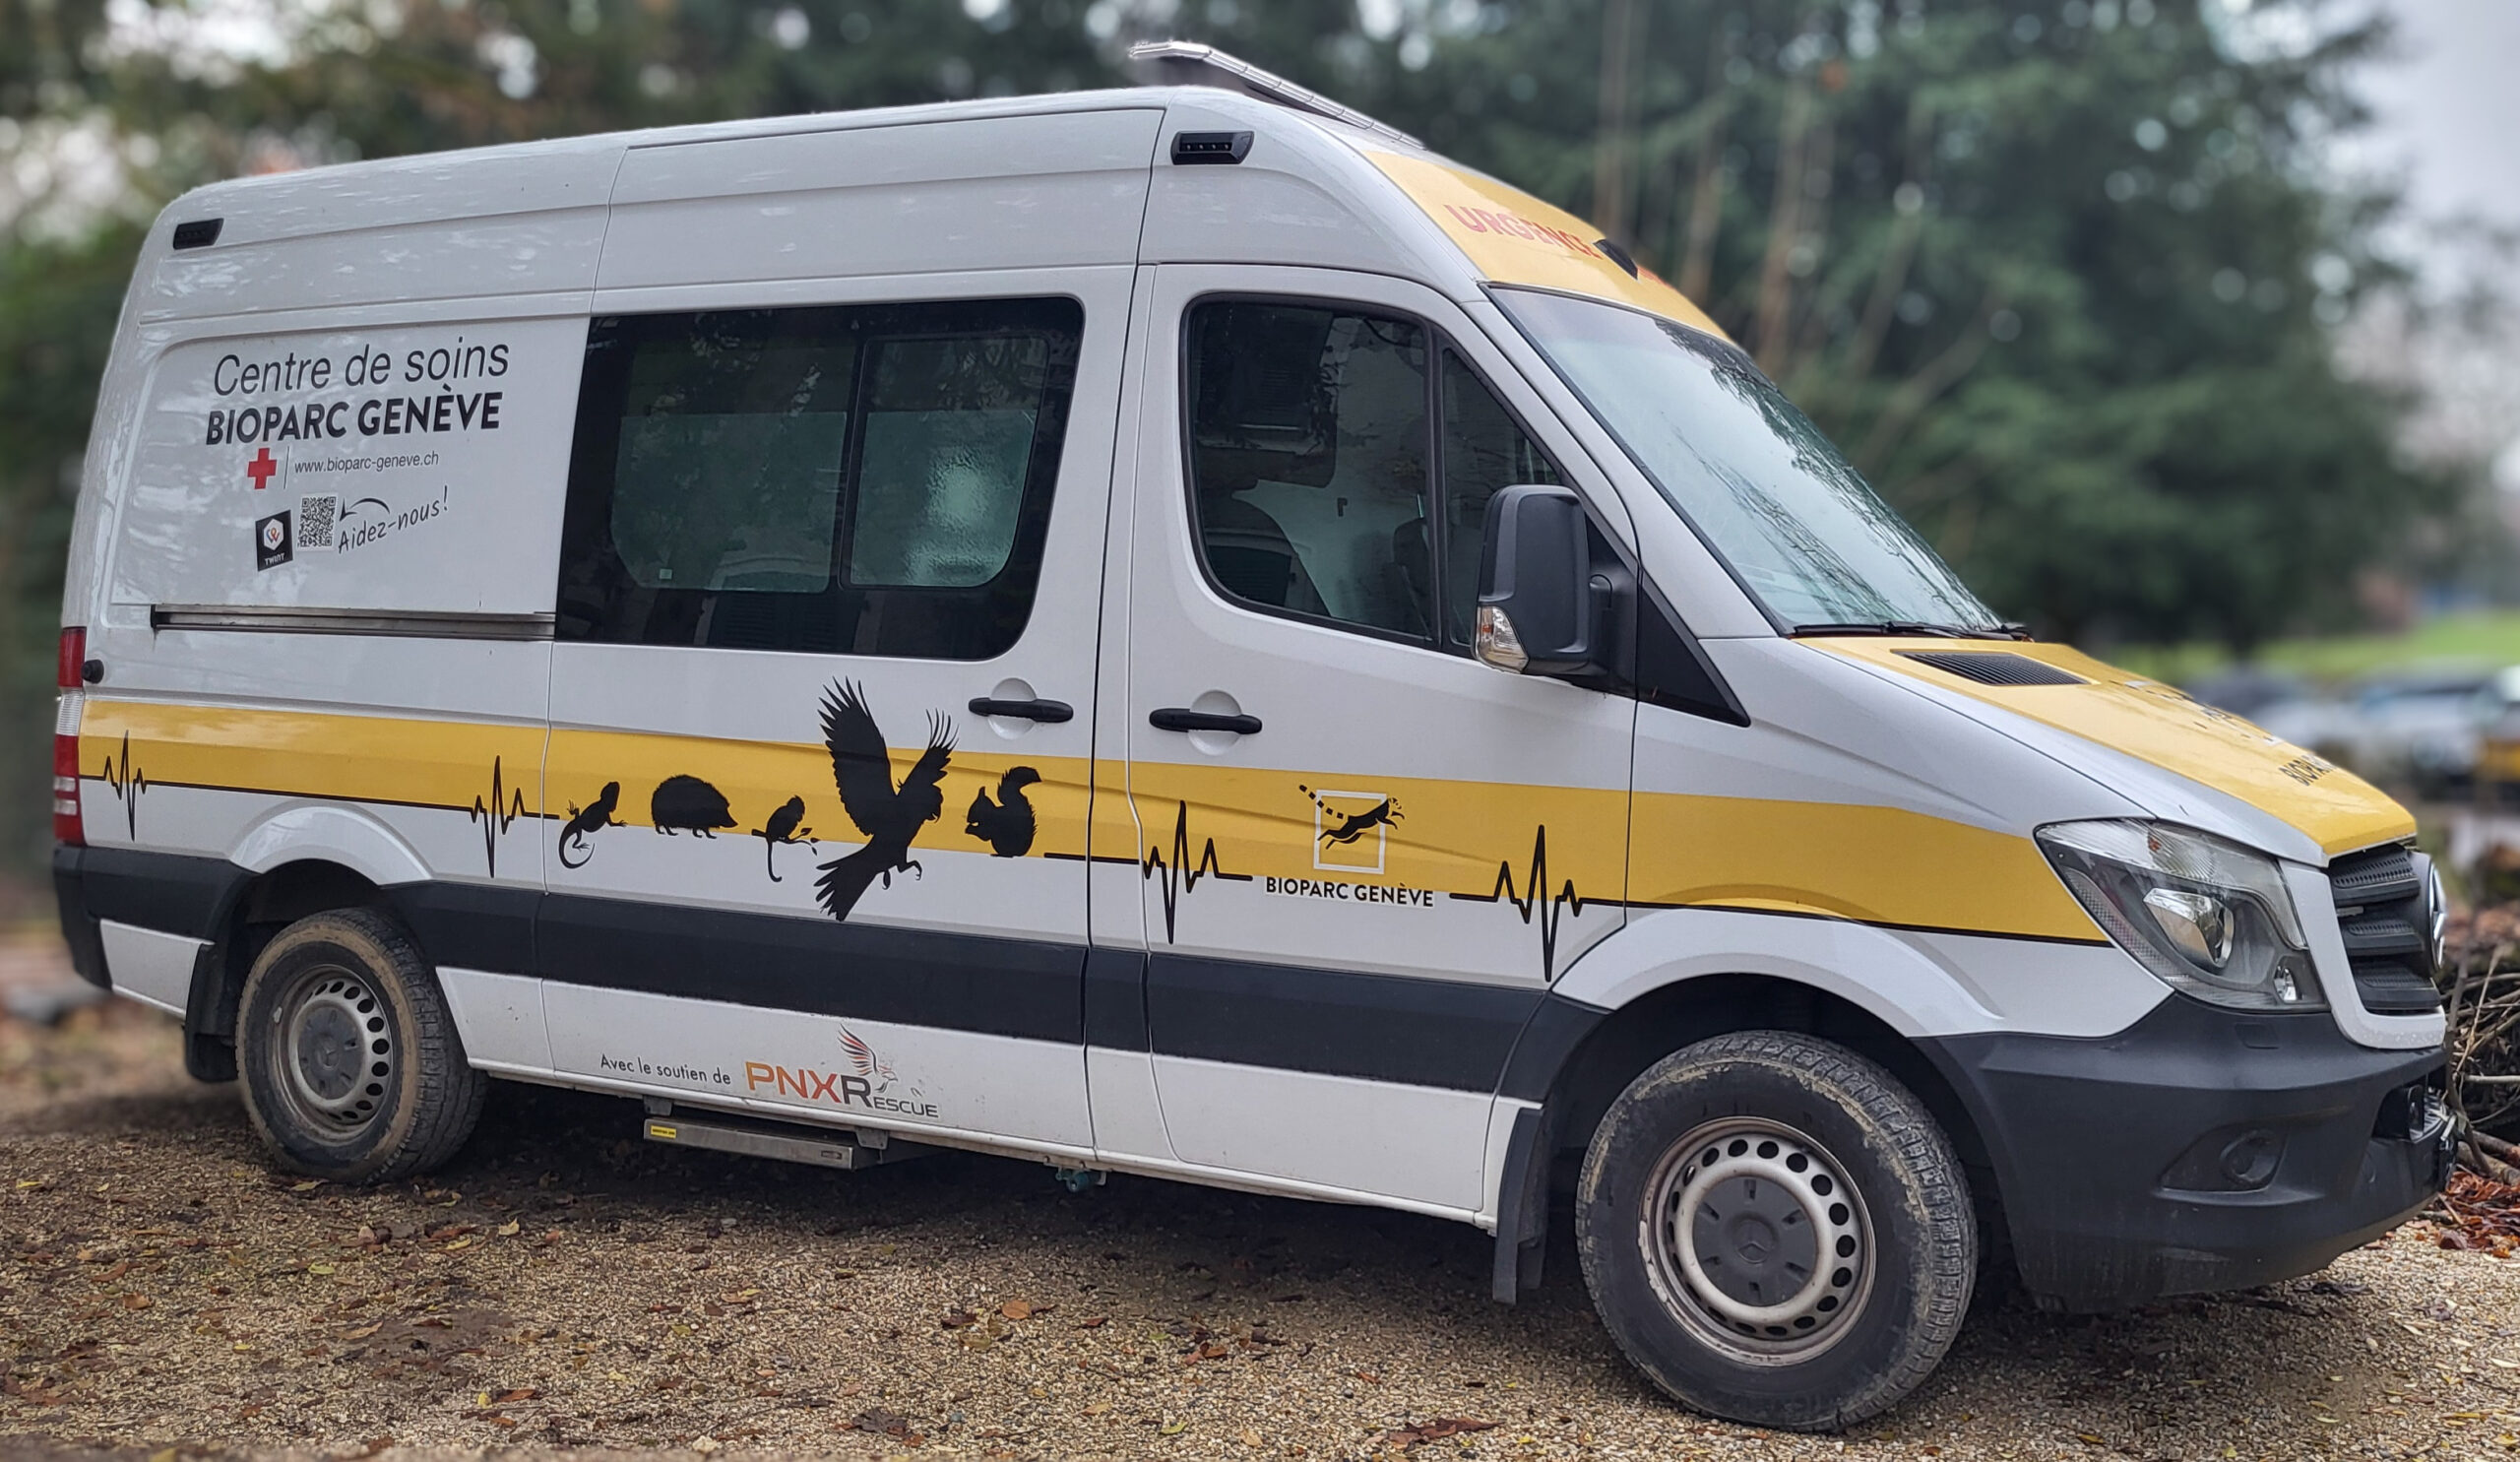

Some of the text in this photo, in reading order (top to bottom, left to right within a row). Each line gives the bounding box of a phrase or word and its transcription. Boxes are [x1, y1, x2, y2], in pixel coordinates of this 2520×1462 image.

[214, 336, 510, 396] Centre de soins
[206, 383, 503, 445] BIOPARC GENÈVE
[294, 451, 440, 474] www.bioparc-geneve.ch
[338, 484, 449, 554] Aidez-nous!
[1265, 876, 1434, 908] BIOPARC GENÈVE
[599, 1053, 731, 1085] Avec le soutien de
